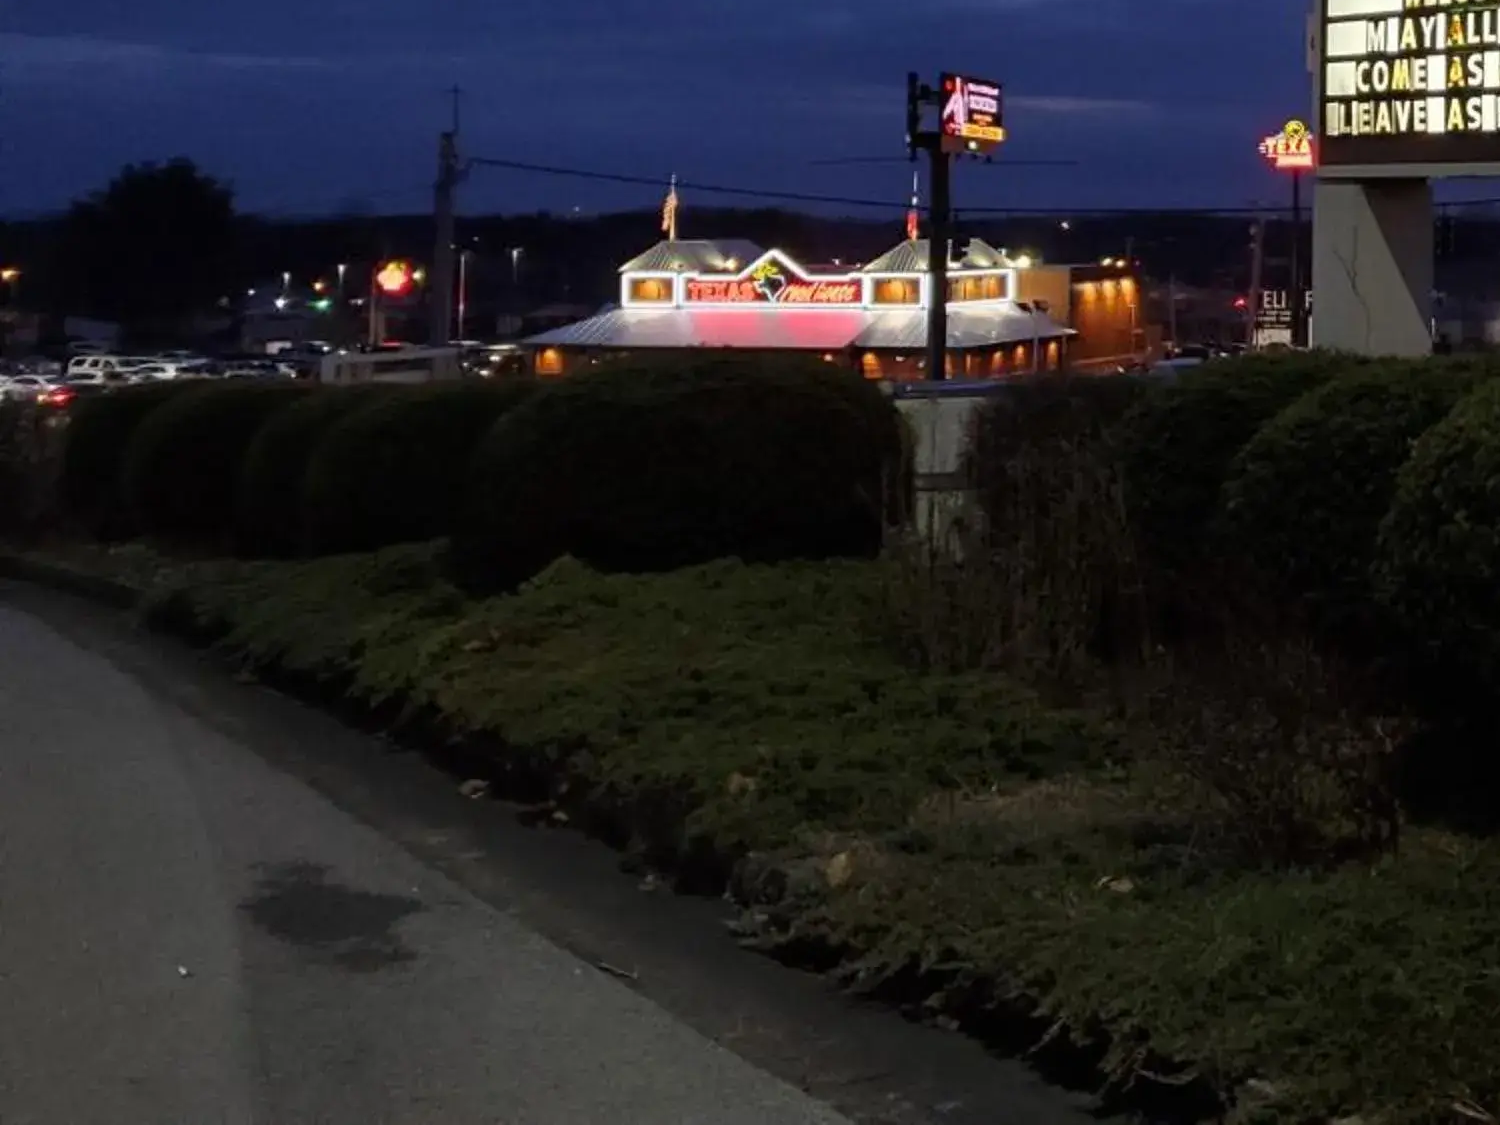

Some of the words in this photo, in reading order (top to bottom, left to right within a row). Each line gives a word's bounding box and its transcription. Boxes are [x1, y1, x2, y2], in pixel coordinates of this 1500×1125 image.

[1368, 15, 1437, 52] MAY
[1447, 8, 1498, 46] ALL
[1356, 57, 1427, 93] COME
[1447, 54, 1484, 87] AS
[1339, 97, 1427, 135] LEAVE
[1447, 96, 1482, 132] AS
[1264, 137, 1311, 155] TEXA
